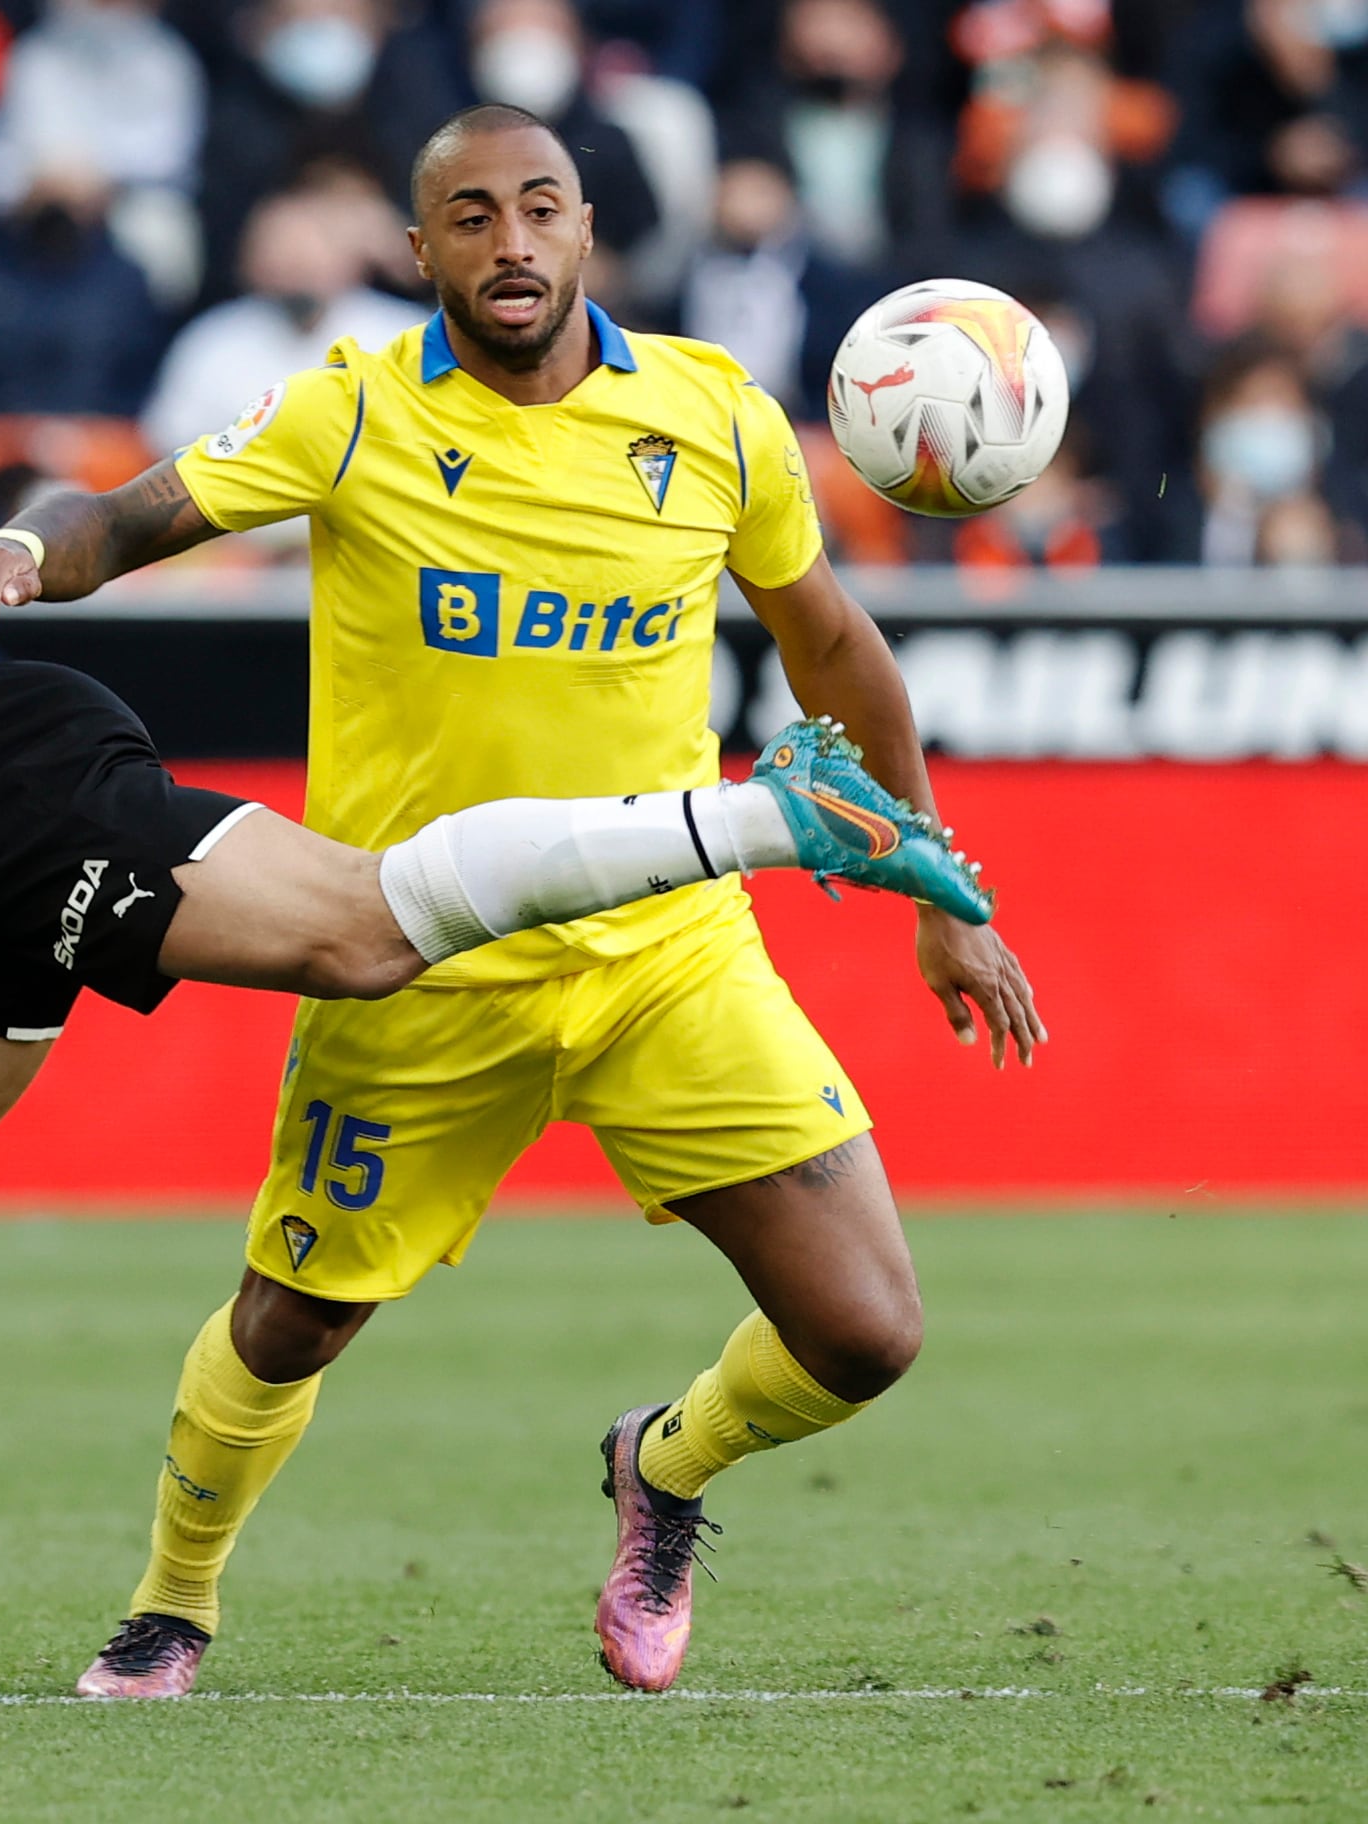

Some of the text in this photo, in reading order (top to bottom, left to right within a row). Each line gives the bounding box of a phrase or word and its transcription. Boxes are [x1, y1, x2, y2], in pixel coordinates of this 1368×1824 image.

[513, 590, 683, 652] Bitci
[53, 859, 110, 971] ŠKODA
[297, 1099, 393, 1212] 15
